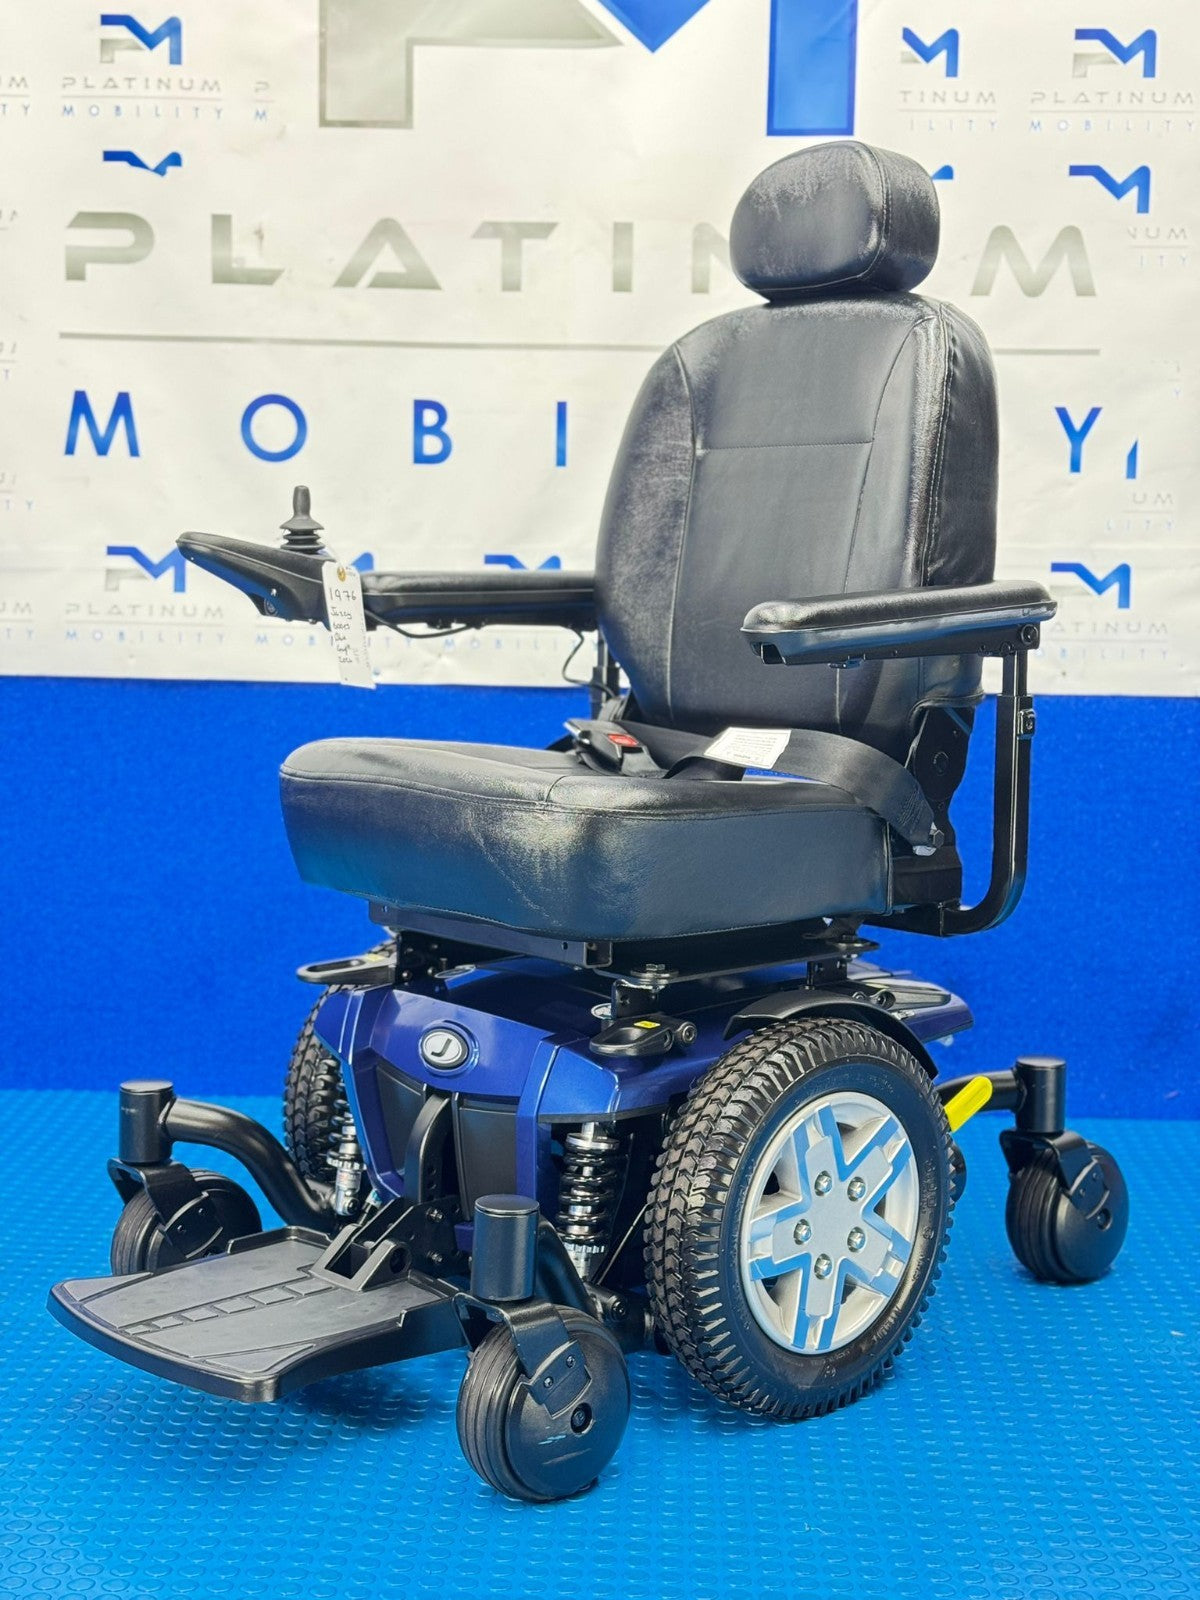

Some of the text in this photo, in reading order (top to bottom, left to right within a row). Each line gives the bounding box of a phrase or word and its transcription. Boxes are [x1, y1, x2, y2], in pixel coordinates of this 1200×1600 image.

[0, 77, 28, 88] M
[62, 76, 222, 92] PLATINUM
[900, 91, 996, 104] TINUM
[1030, 92, 1194, 104] PLATINUM
[62, 106, 222, 119] MOBILITY
[1029, 120, 1194, 132] MOBILITY
[65, 211, 1096, 298] PLATINM
[64, 390, 1103, 473] MOBIY
[329, 588, 357, 601] 1976
[65, 602, 225, 618] PLATINUM
[1050, 621, 1168, 634] ATINUM
[66, 630, 225, 644] MOBILITY
[256, 634, 413, 648] MOBIITY
